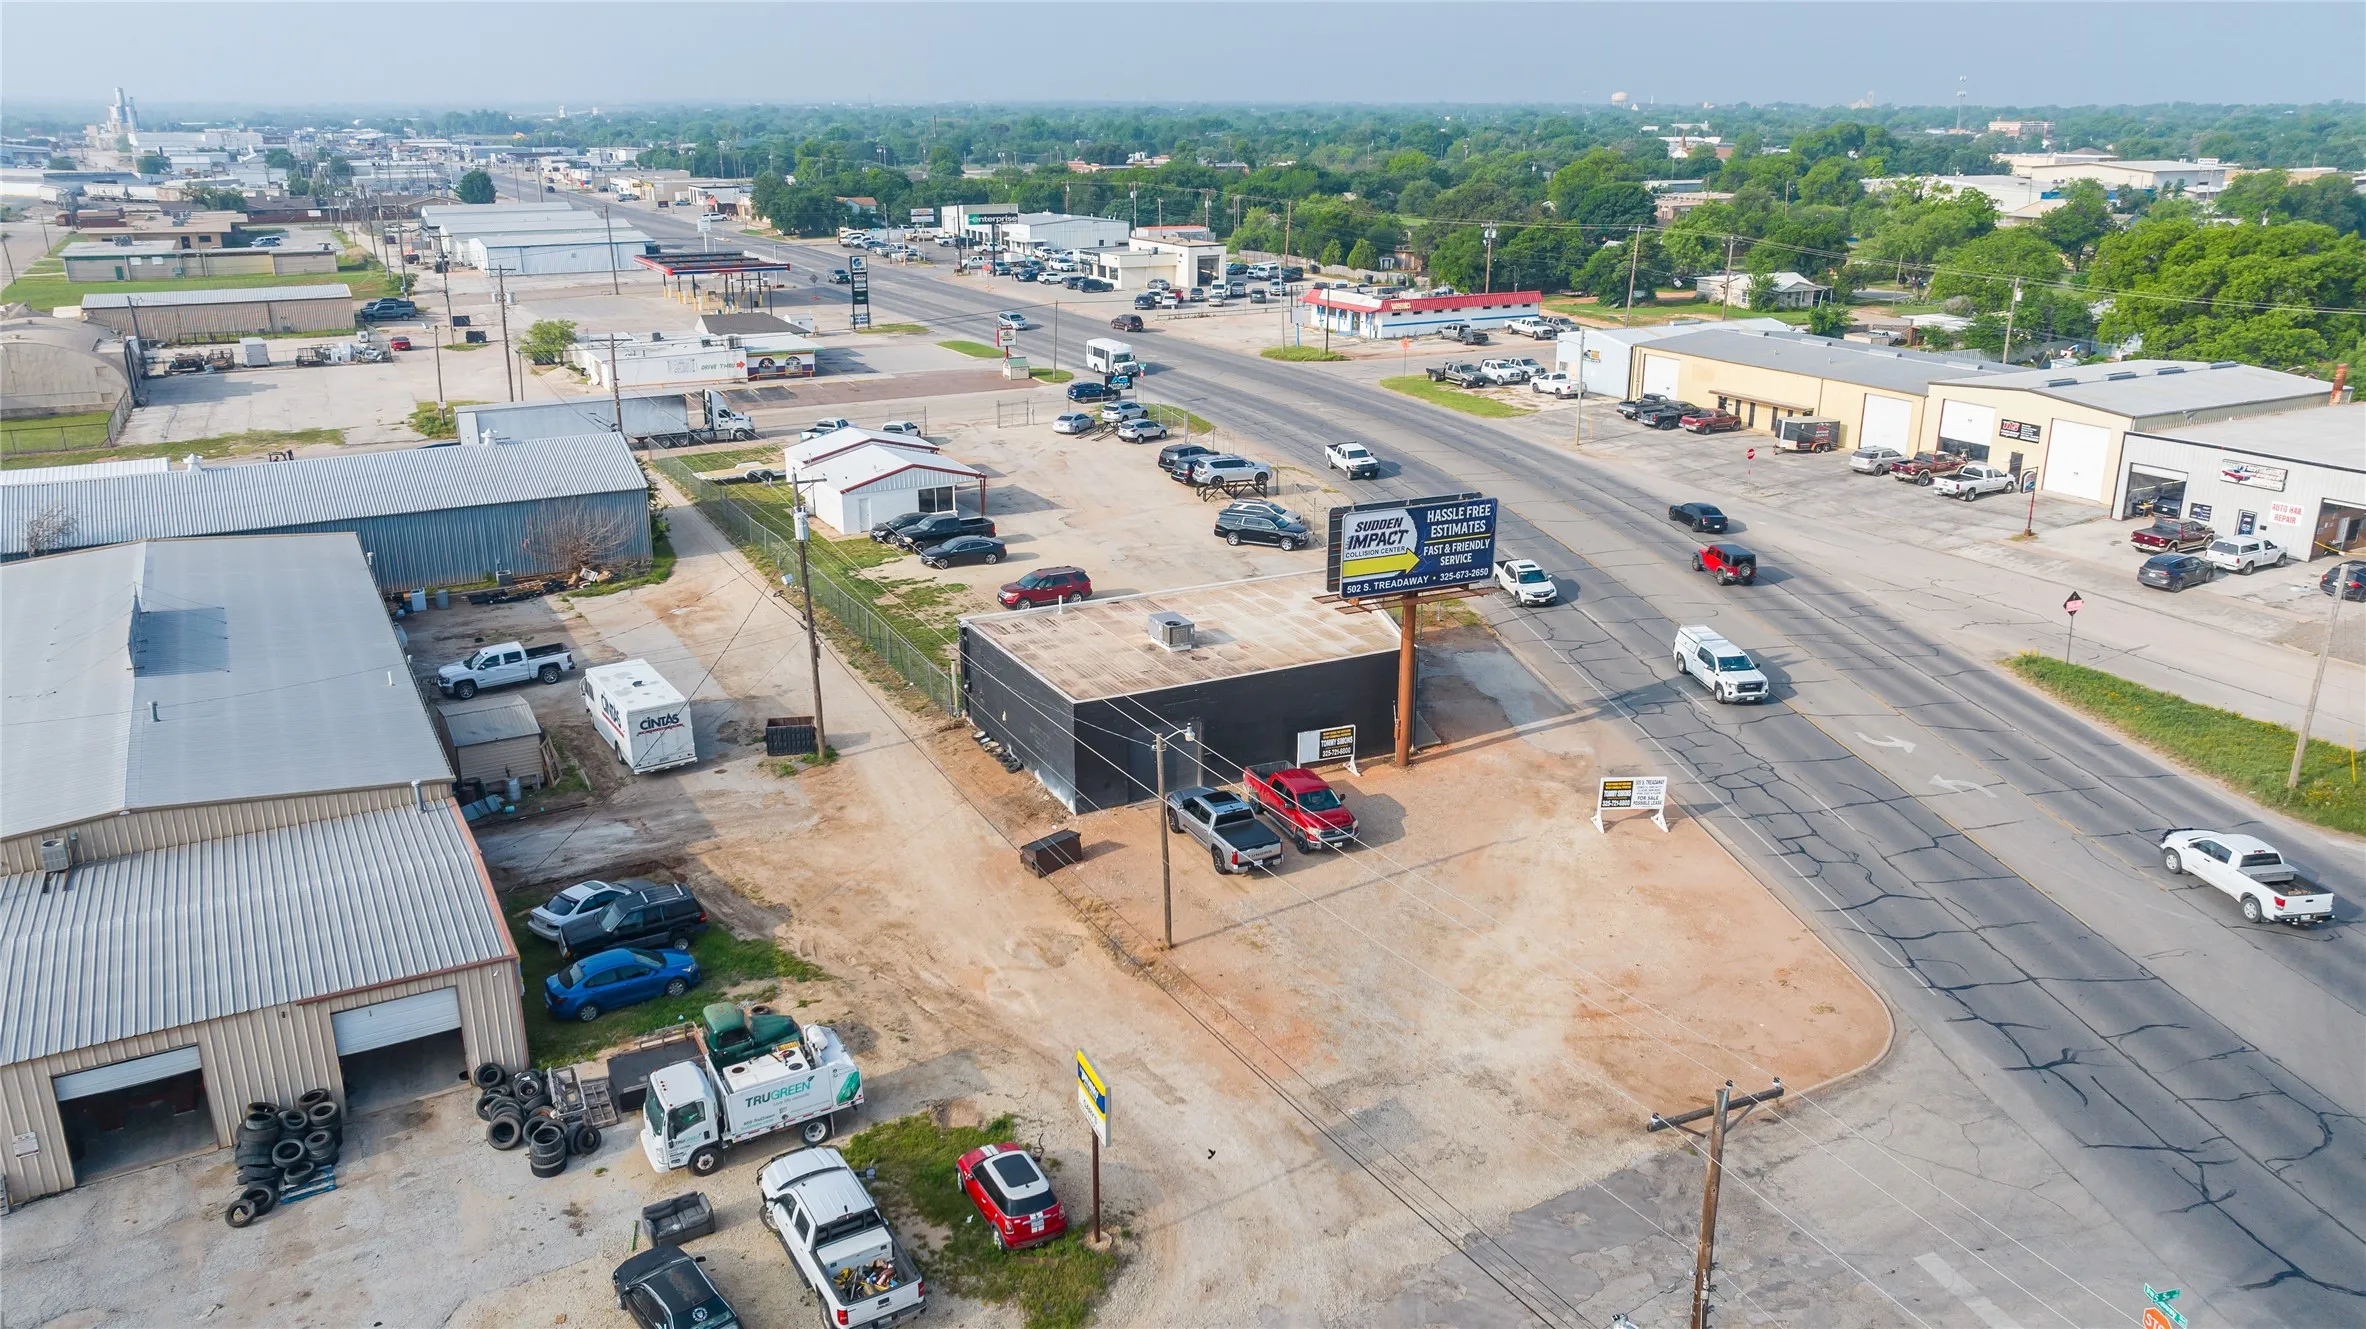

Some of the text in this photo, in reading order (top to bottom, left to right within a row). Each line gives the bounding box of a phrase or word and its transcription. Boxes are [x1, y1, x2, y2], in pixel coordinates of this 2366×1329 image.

[971, 215, 1018, 224] enterprise
[1427, 504, 1491, 522] HASSLE FREE
[2272, 503, 2288, 513] AUTO
[1355, 517, 1404, 532] SUDDEN
[2274, 513, 2297, 524] REPAIR
[1431, 520, 1486, 537] ESTIMATES
[1347, 529, 1409, 550] IMPACT
[1424, 539, 1490, 556] FAST & FRIENDLY
[1345, 546, 1405, 558] COLLISION CENTER
[1440, 553, 1472, 566] SERVICE
[1347, 567, 1489, 594] 502 S. TREADAWAY 325-673-2650
[640, 713, 680, 730] CINTAS
[1248, 850, 1273, 859] TUNDRA
[745, 1080, 811, 1108] TRUGREEN
[2145, 1313, 2165, 1329] STO
